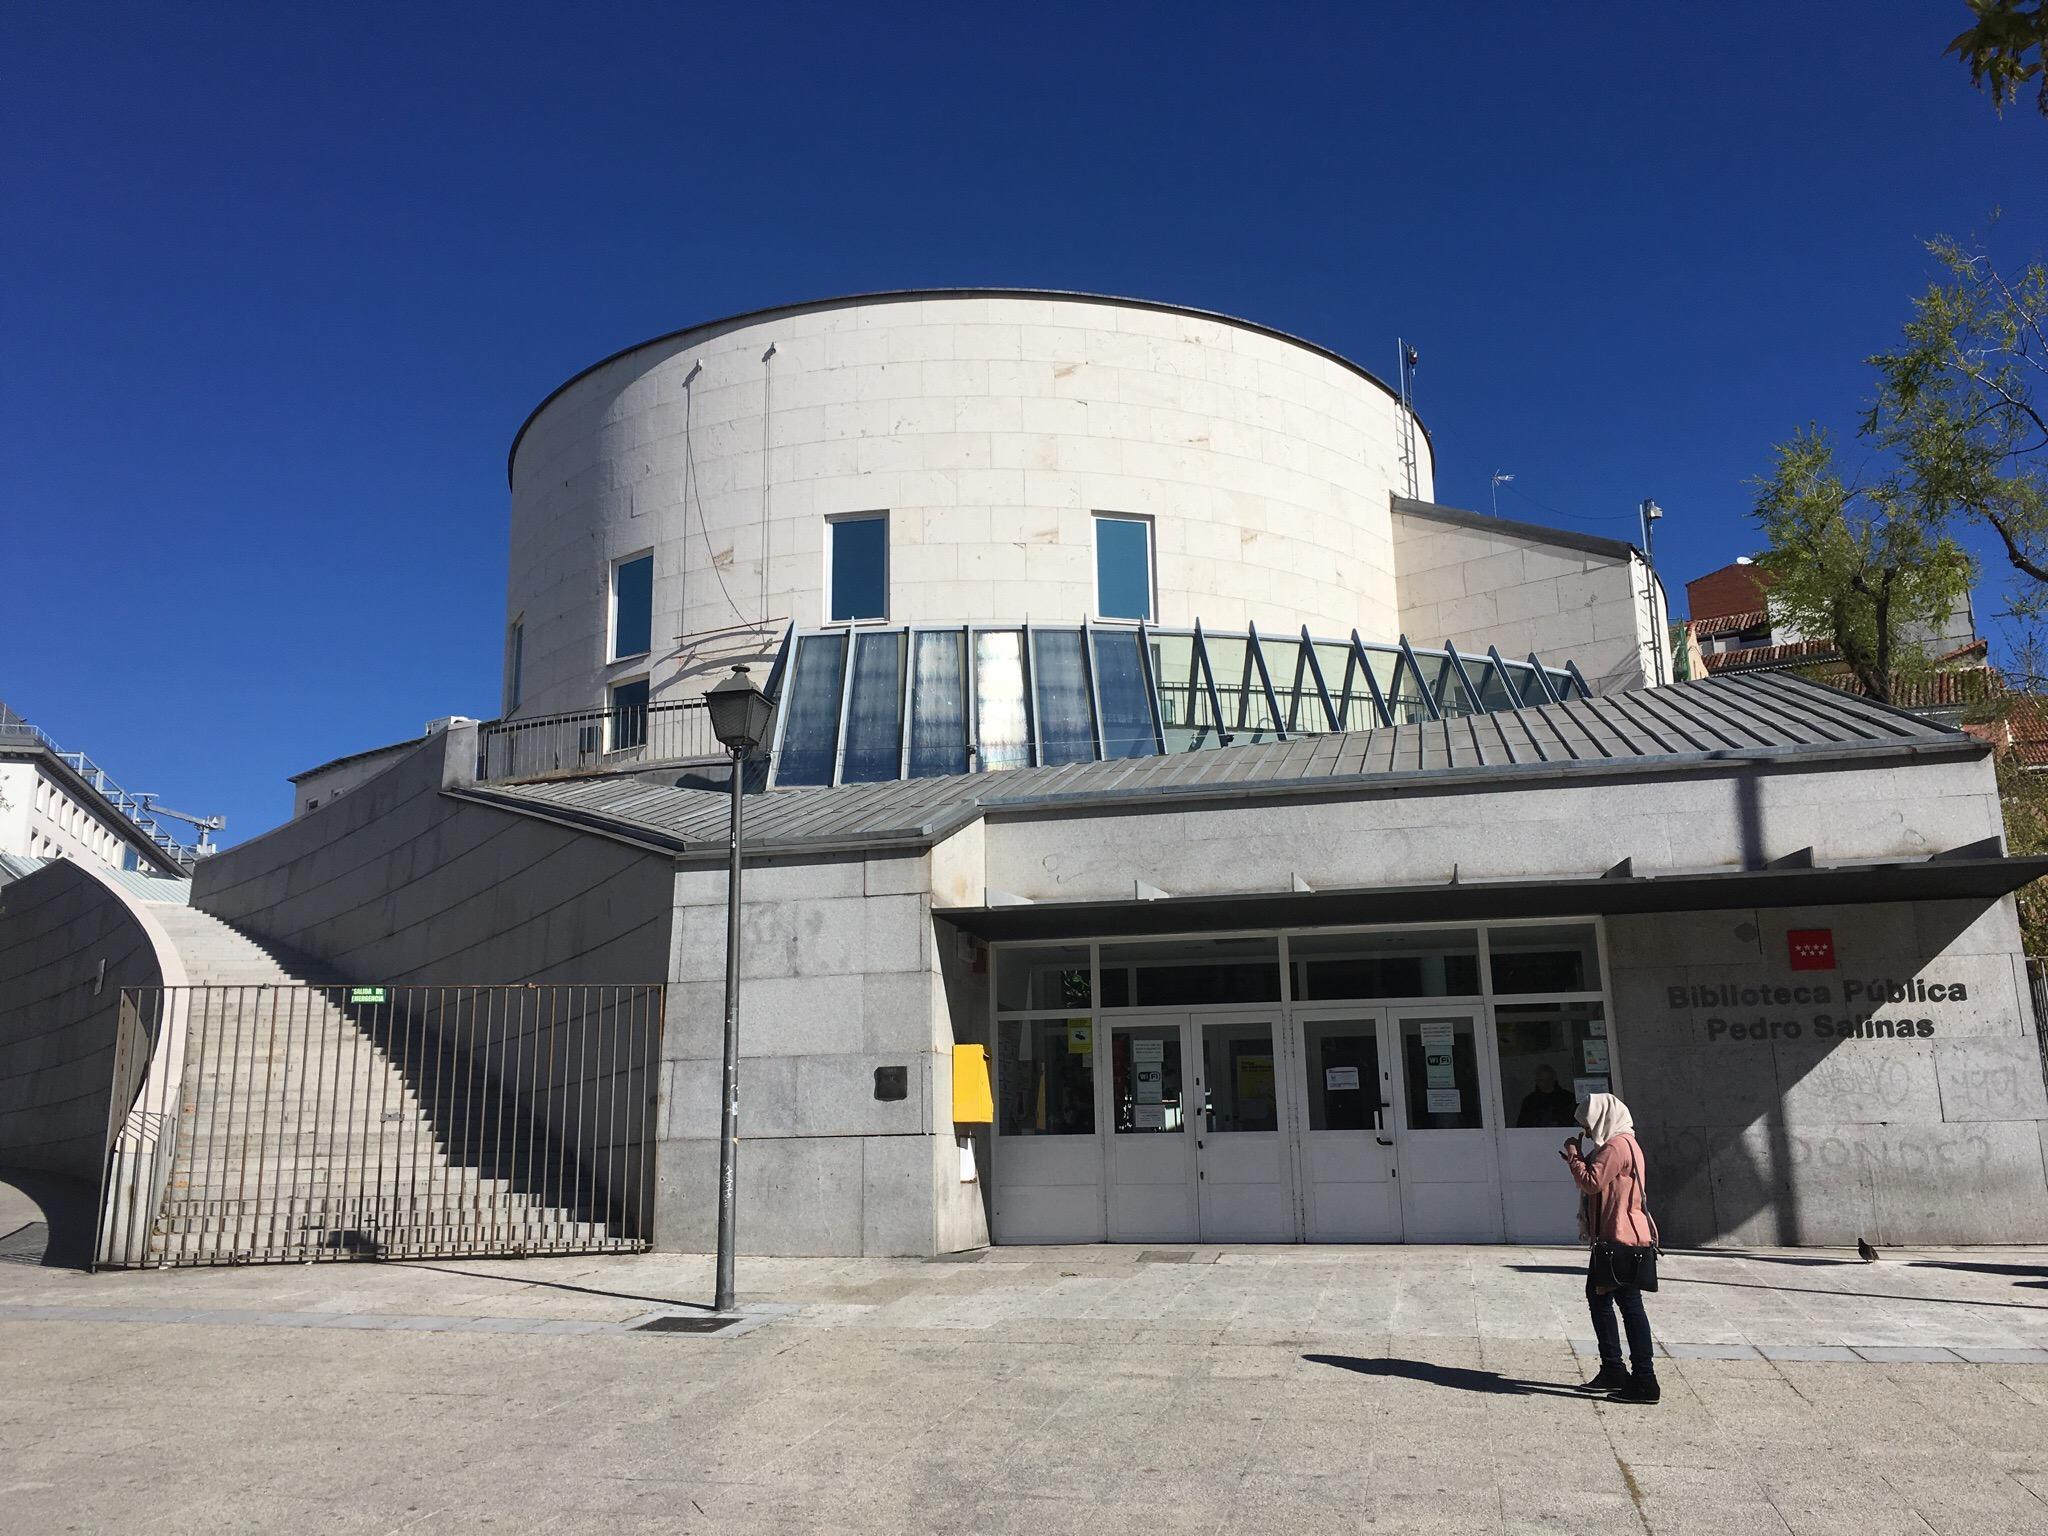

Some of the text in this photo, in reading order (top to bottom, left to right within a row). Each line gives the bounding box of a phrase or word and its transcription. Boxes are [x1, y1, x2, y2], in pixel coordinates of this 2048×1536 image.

[1667, 979, 1967, 1009] Biblioteca Pública
[1707, 1014, 1935, 1041] Pedro Salinas
